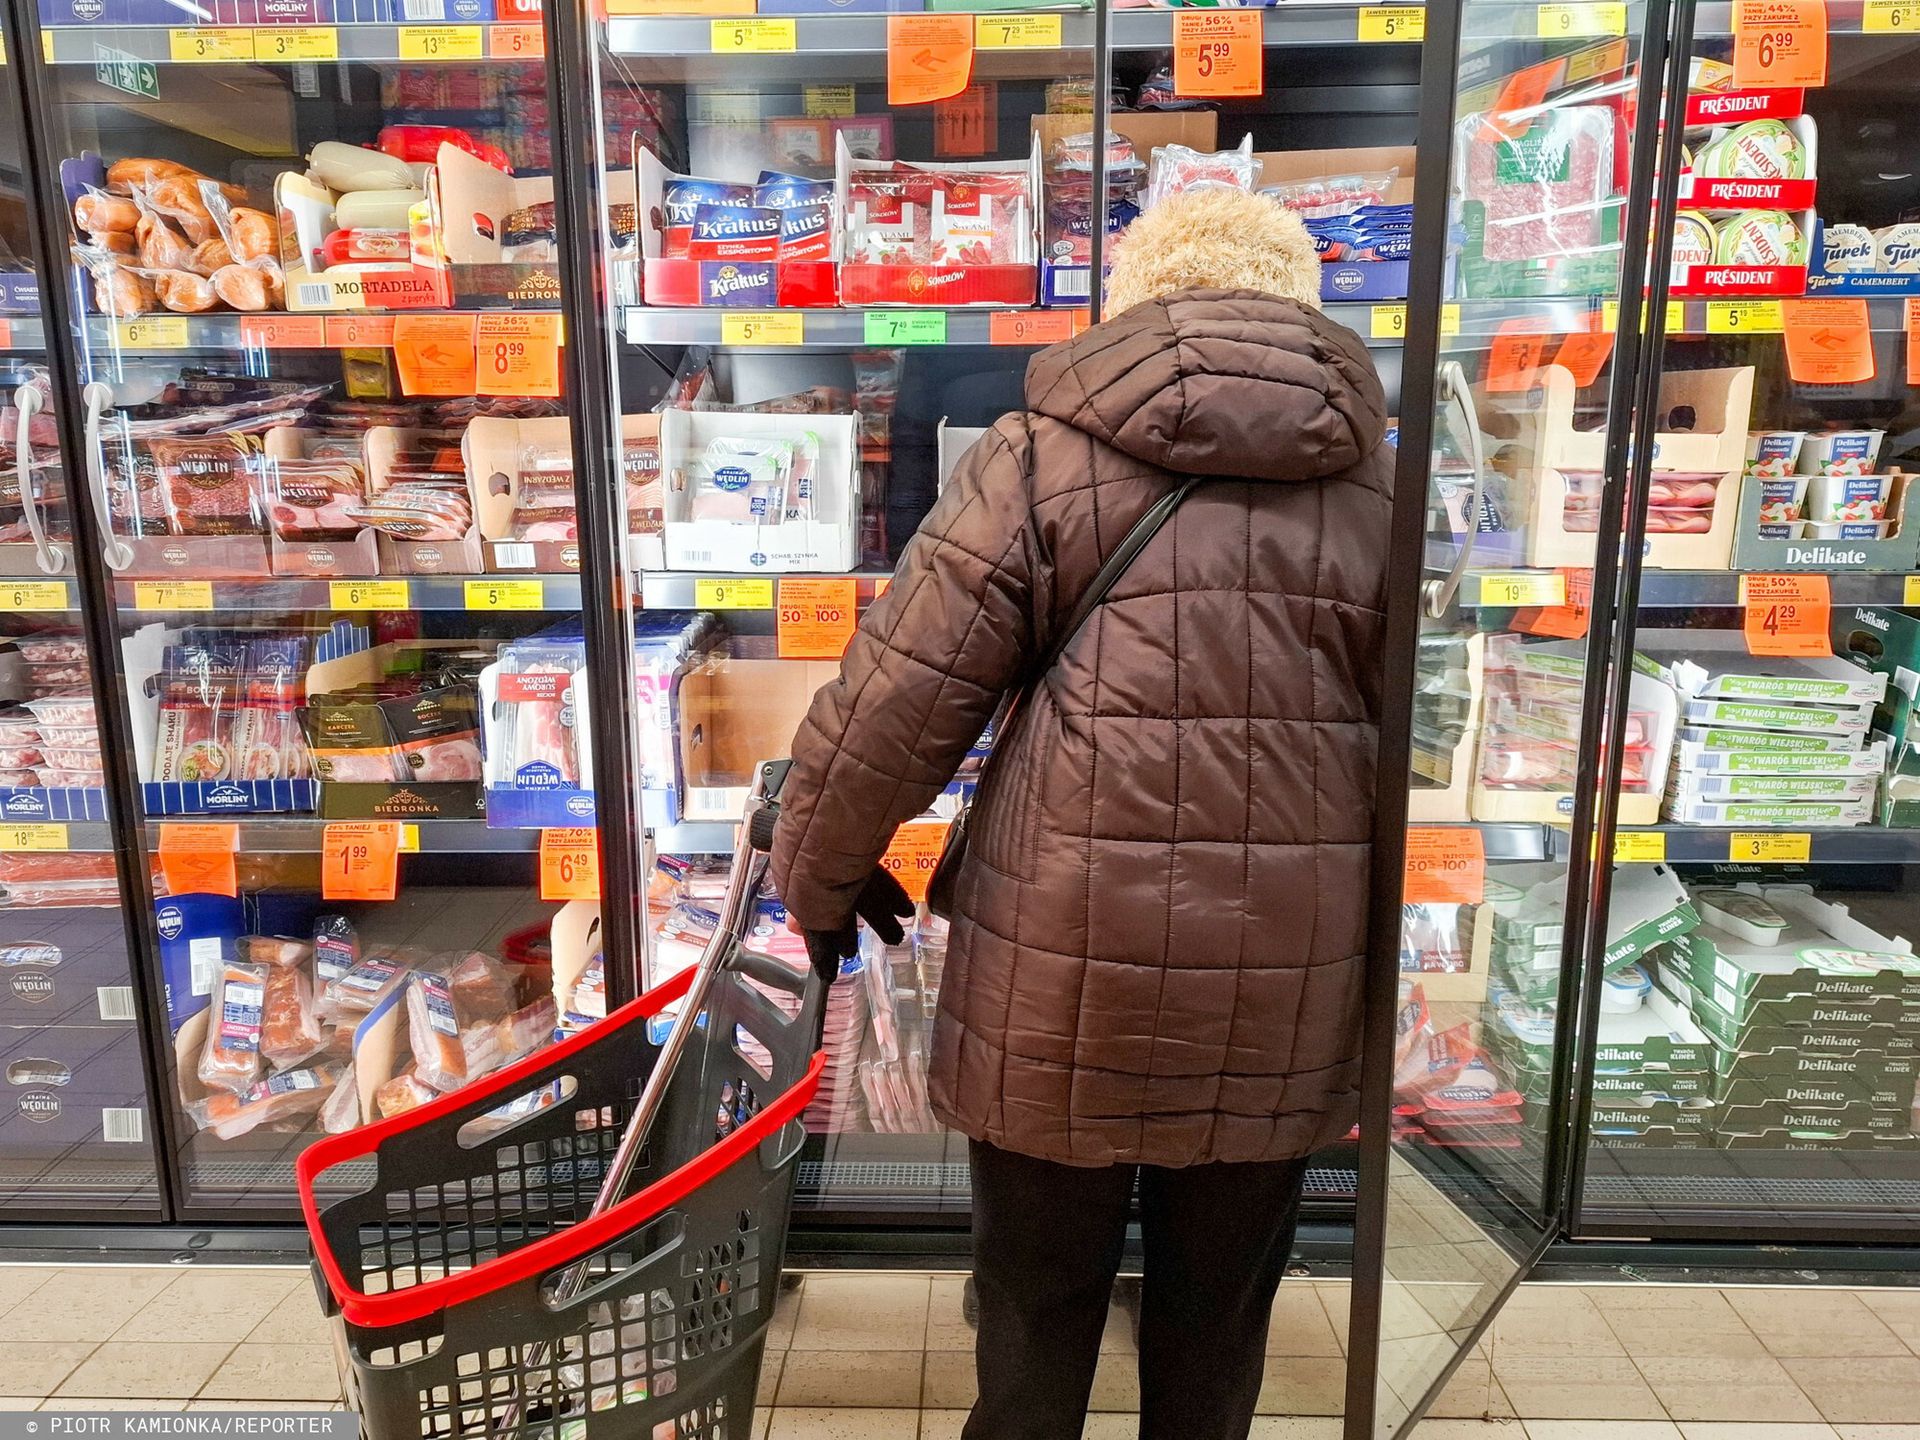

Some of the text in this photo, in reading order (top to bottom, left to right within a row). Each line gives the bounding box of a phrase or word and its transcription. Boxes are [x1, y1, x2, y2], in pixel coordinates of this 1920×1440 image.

[265, 4, 308, 12] MORLINY
[1768, 5, 1795, 13] 44%
[1206, 16, 1232, 26] 56%
[1561, 14, 1570, 29] 9
[1892, 10, 1900, 26] 6
[1386, 19, 1394, 34] 5
[735, 30, 743, 45] 5
[1002, 27, 1010, 43] 7
[196, 40, 205, 55] 3
[276, 38, 285, 53] 3
[422, 37, 438, 54] 13
[513, 35, 521, 50] 5
[1758, 34, 1774, 68] 6
[1776, 33, 1793, 46] 99
[1198, 44, 1212, 77] 5
[1213, 43, 1230, 56] 99
[1700, 96, 1770, 115] PRÉSIDENT
[1711, 182, 1782, 200] PRÉSIDENT
[698, 215, 778, 238] Krakus
[717, 246, 773, 255] EKSPORTOWA
[711, 270, 768, 297] Krakus
[928, 270, 966, 286] SOKOŁÓW
[1336, 276, 1361, 284] WĘDLIN
[1705, 269, 1774, 286] PRÉSIDENT
[1808, 274, 1910, 289] Turek CAMEMBERT
[334, 280, 434, 296] MORTADELA
[507, 291, 560, 300] BIEDRON
[1393, 314, 1402, 330] 9
[1729, 310, 1738, 326] 5
[129, 326, 137, 341] 6
[267, 326, 275, 342] 3
[348, 326, 356, 341] 6
[744, 324, 752, 338] 5
[890, 322, 898, 337] 7
[1015, 322, 1023, 337] 9
[495, 342, 508, 374] 8
[509, 342, 524, 355] 99
[181, 461, 228, 474] WĘDLIN
[624, 459, 660, 471] WĘDLIN
[189, 475, 222, 486] Select
[524, 475, 563, 485] WĘDZARNI
[716, 475, 748, 485] WĘDLIN
[280, 487, 330, 498] WĘDLIN
[1786, 547, 1866, 564] Delikate
[1772, 578, 1797, 587] 50%
[14, 592, 22, 606] 6
[156, 590, 164, 604] 7
[351, 589, 359, 604] 6
[489, 590, 497, 604] 5
[716, 587, 724, 601] 9
[782, 610, 801, 622] 50
[1763, 605, 1778, 636] 4
[1780, 605, 1796, 618] 29
[1855, 607, 1890, 632] Delikate
[257, 665, 291, 675] MORLINY
[1747, 680, 1824, 692] TWARÓG WIEJSKI
[1741, 706, 1814, 720] TWARÓG WIEJSKI
[163, 712, 176, 782] DODAJE SMAKU
[1732, 734, 1804, 748] TWARÓG WIEJSKI
[1754, 754, 1827, 766] TWARÓG WIEJSKI
[518, 773, 558, 784] WĘDLIN
[1754, 779, 1823, 790] TWARÓG WIEJSKI
[207, 795, 248, 804] MORLINY
[1749, 806, 1819, 817] TWARÓG WIEJSKI
[15, 831, 27, 845] 18
[569, 829, 592, 837] 70%
[1752, 841, 1760, 855] 3
[340, 846, 349, 874] 1
[353, 846, 366, 857] 99
[884, 858, 902, 869] 50
[1407, 860, 1427, 871] 50
[560, 854, 573, 882] 6
[574, 854, 587, 866] 49
[1712, 864, 1762, 873] Delikate
[13, 981, 51, 993] WĘDLIN
[1815, 981, 1874, 993] Delikate
[1813, 1010, 1872, 1022] Delikate
[1802, 1035, 1860, 1046] Delikate
[1596, 1049, 1644, 1060] elikate
[1798, 1060, 1856, 1071] Delikate
[1786, 1088, 1844, 1100] Delikate
[20, 1101, 57, 1112] WĘDLIN
[1593, 1112, 1650, 1123] Delikate
[1783, 1114, 1841, 1126] Delikate
[1590, 1139, 1645, 1149] Delikate
